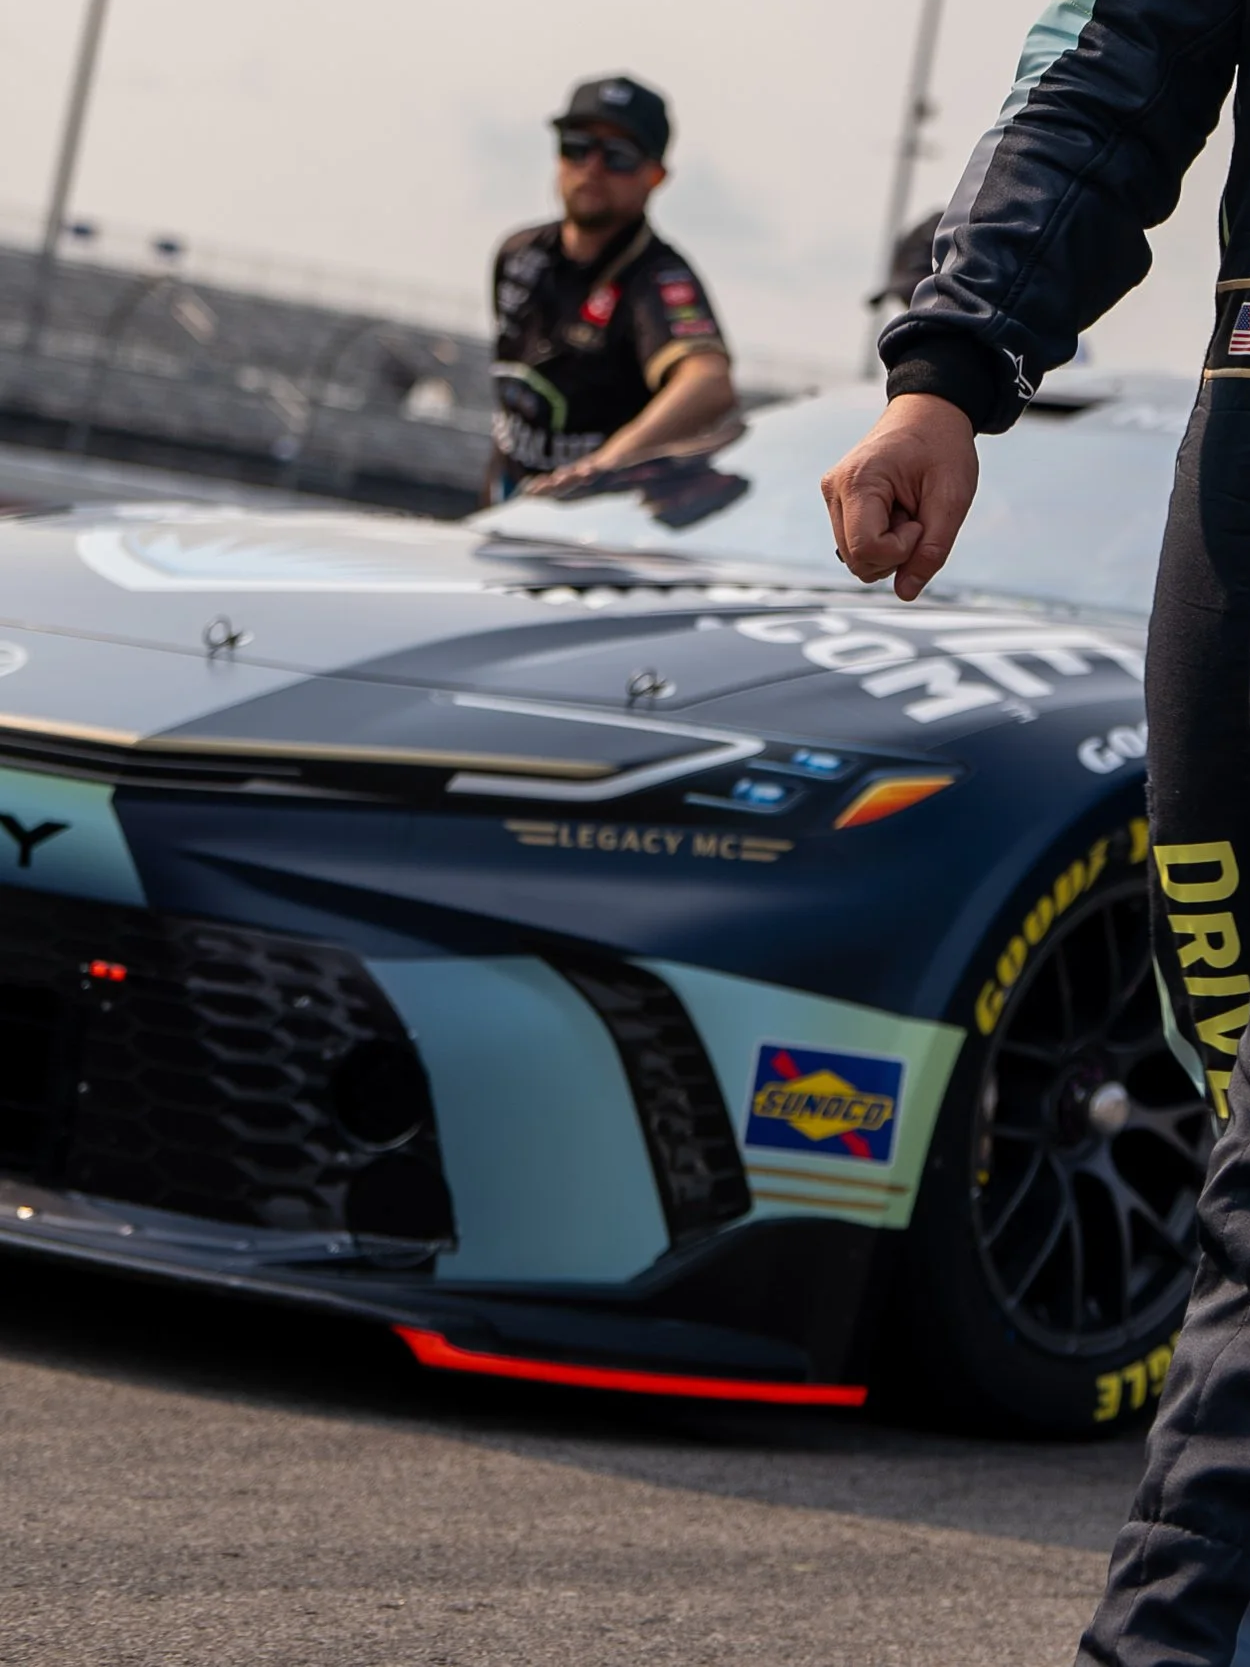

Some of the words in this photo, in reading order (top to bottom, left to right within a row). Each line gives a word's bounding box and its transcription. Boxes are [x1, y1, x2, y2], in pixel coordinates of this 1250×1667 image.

[557, 823, 684, 855] LEGACY
[692, 832, 742, 859] MC
[759, 1088, 888, 1126] SUNOCO
